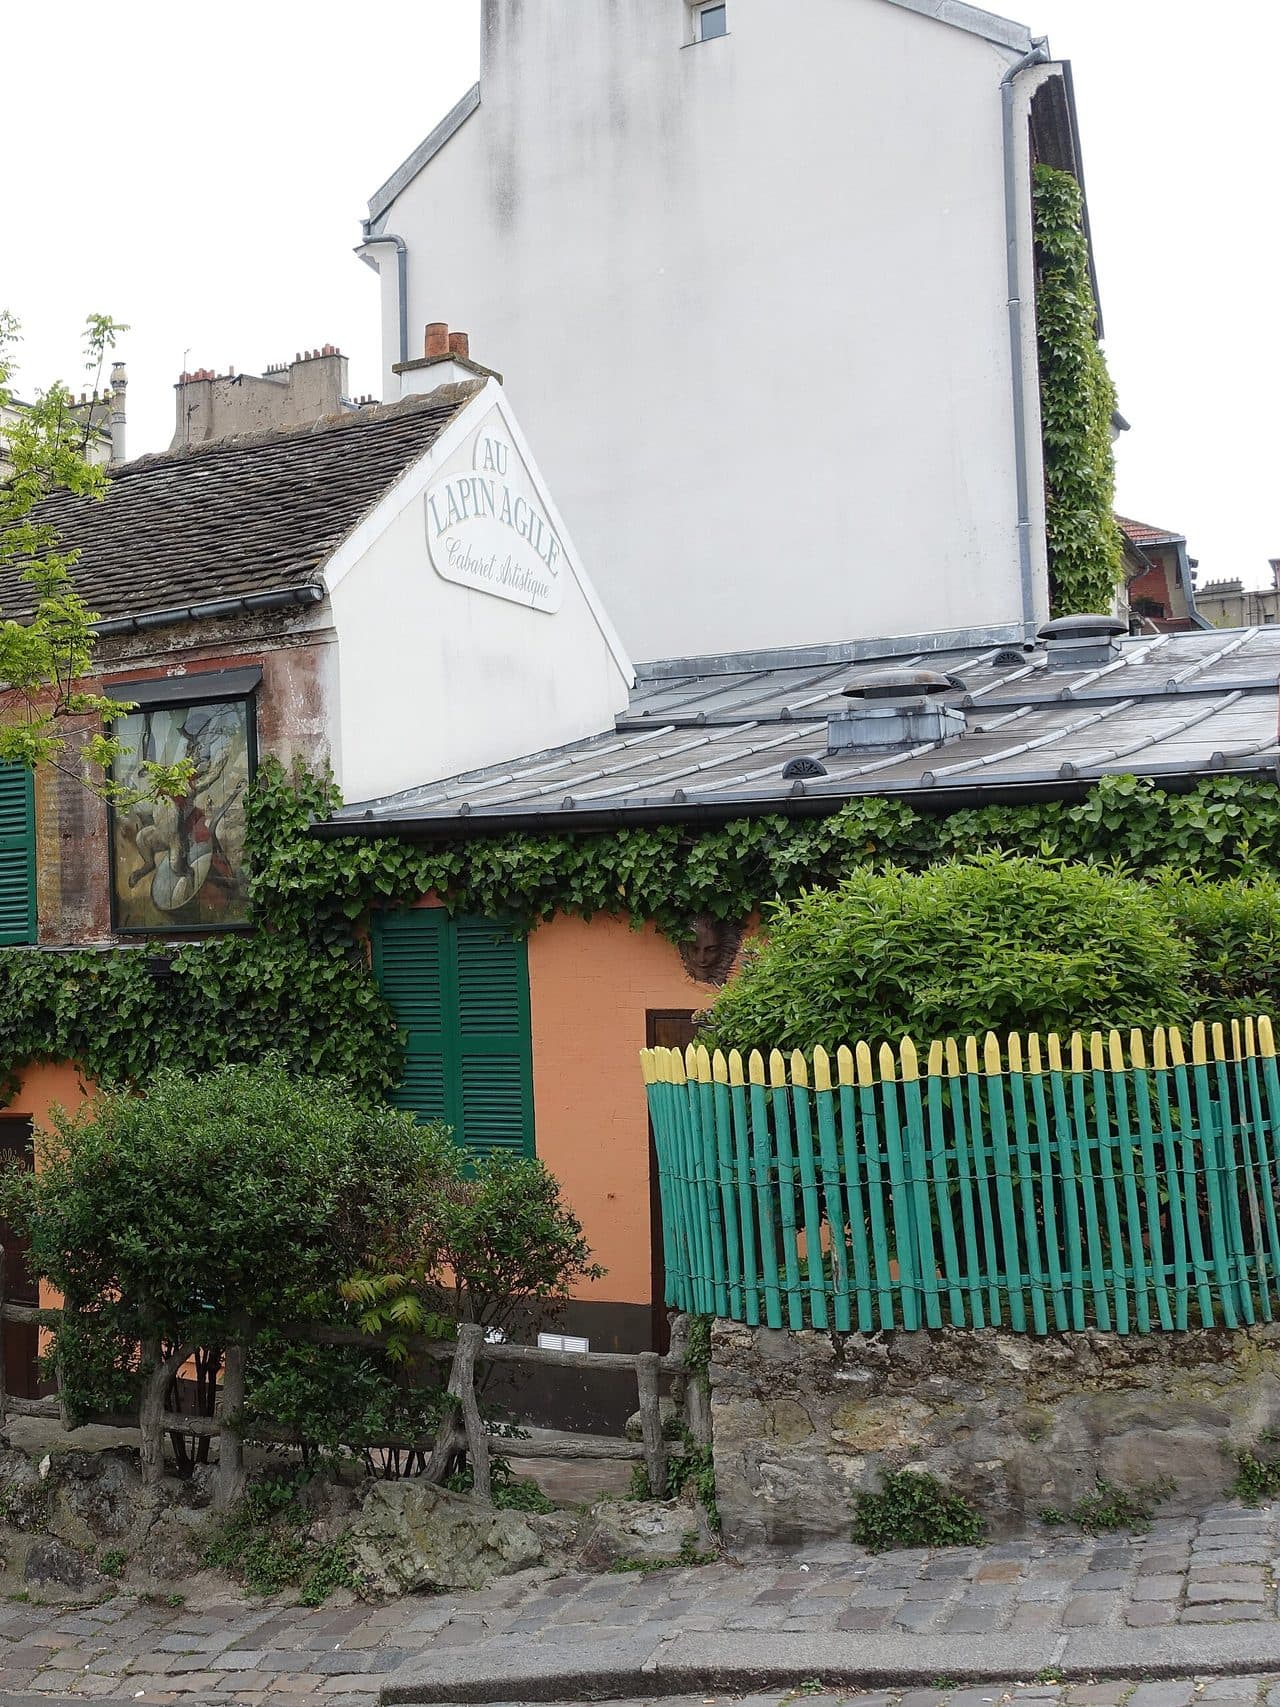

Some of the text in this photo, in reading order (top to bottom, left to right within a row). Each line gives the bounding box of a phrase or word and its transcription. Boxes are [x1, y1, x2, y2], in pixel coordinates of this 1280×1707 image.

[483, 438, 508, 475] AU
[428, 477, 561, 577] LAPIN AGILE
[445, 537, 550, 605] Cabaret Artistique
